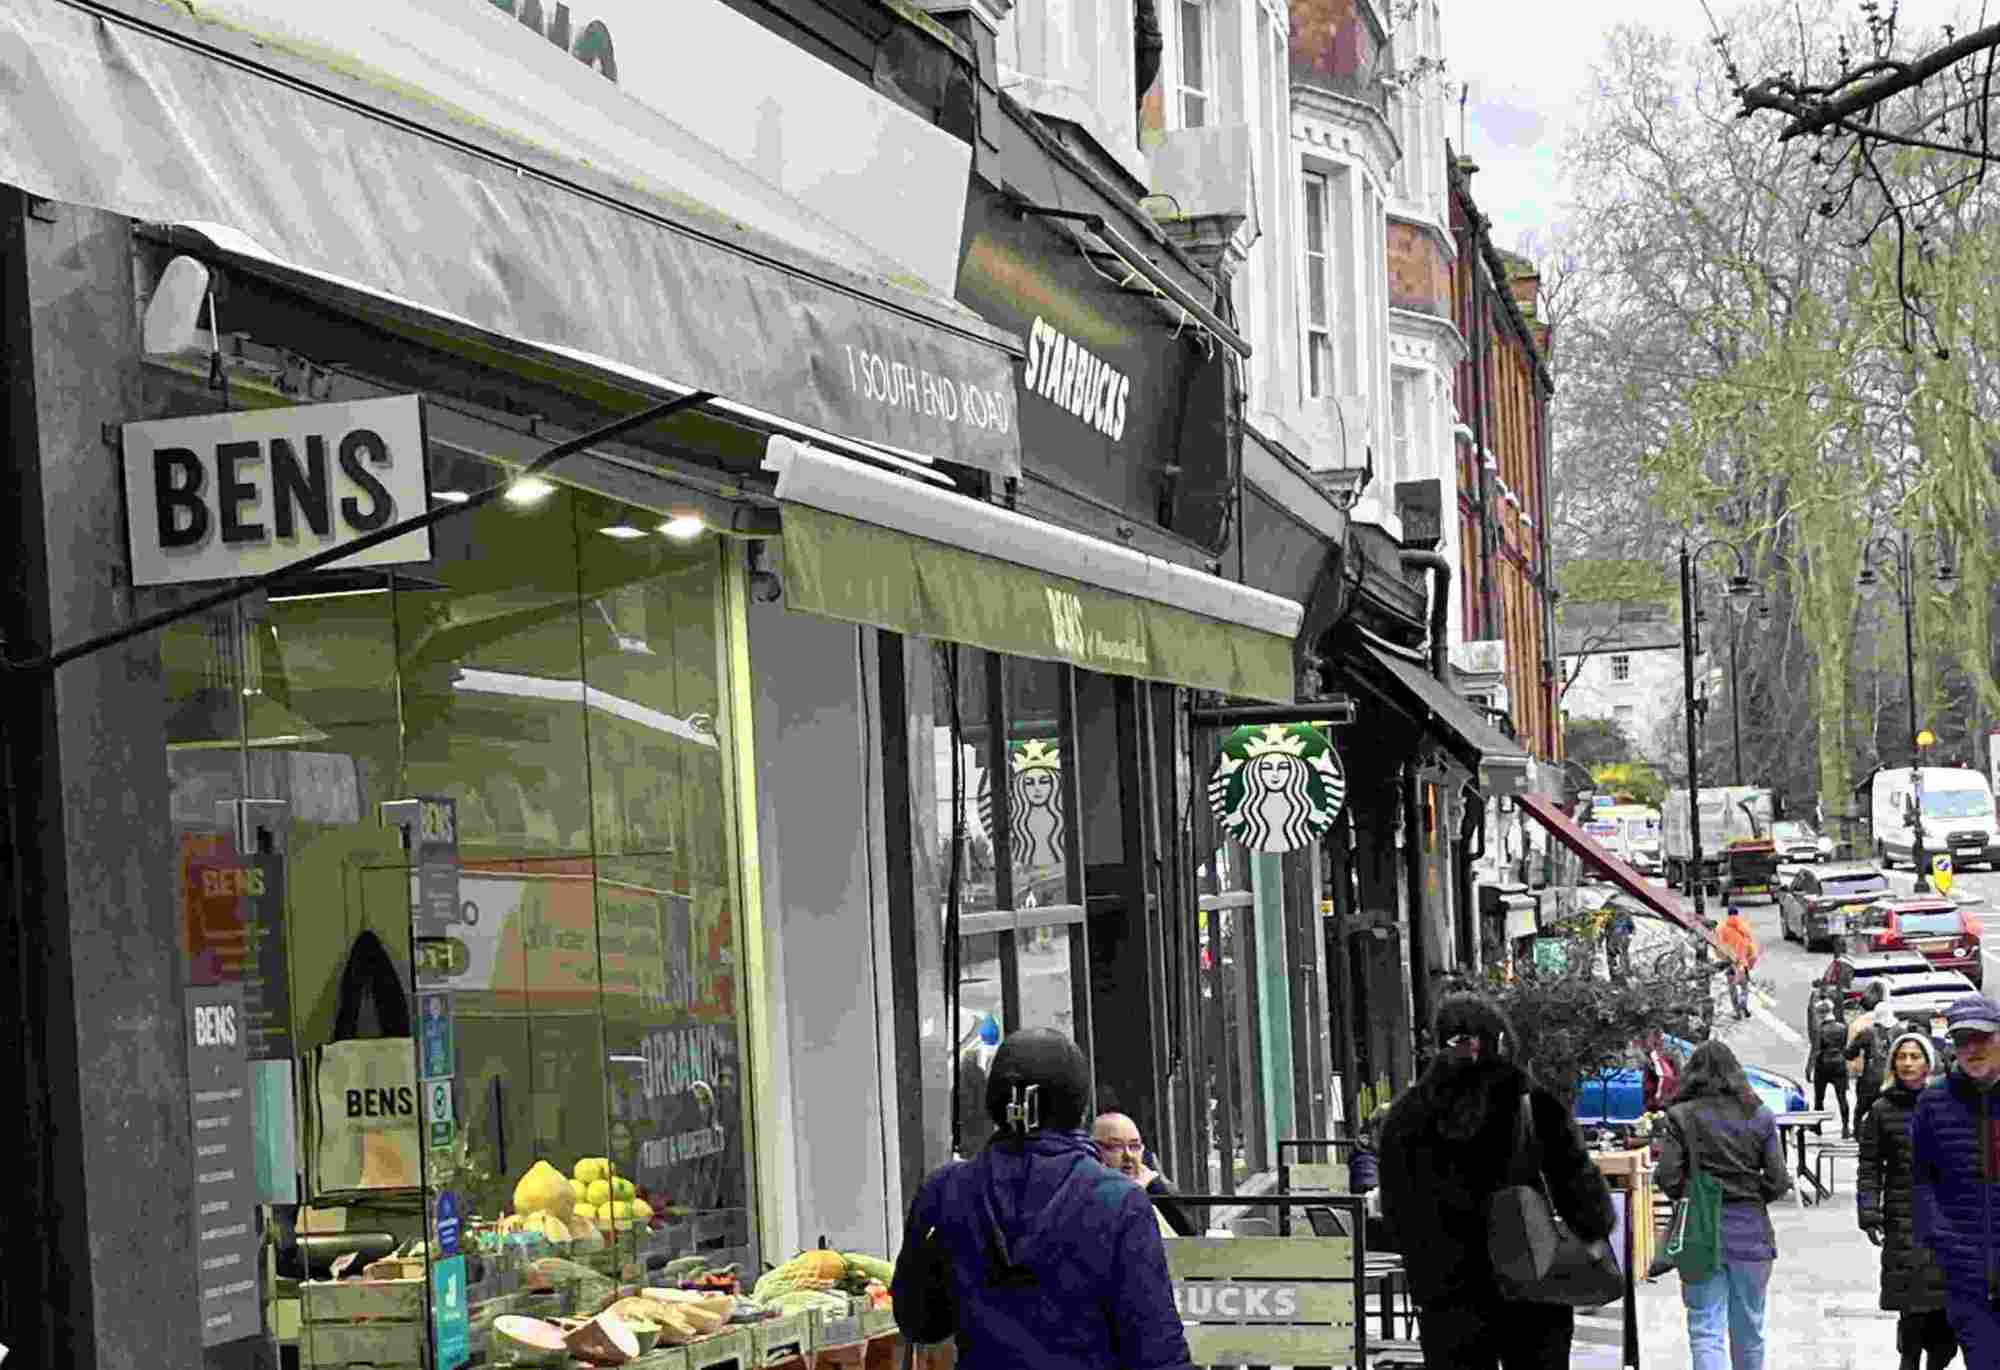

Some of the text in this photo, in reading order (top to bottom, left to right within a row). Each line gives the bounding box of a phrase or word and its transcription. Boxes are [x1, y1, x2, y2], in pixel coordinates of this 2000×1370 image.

[845, 344, 1009, 435] 1 SOUTH END ROAD
[1025, 315, 1129, 442] STARBUCKS
[153, 428, 393, 548] BENS
[201, 867, 266, 897] BENS
[194, 1004, 237, 1047] BENS
[346, 1086, 413, 1118] BENS
